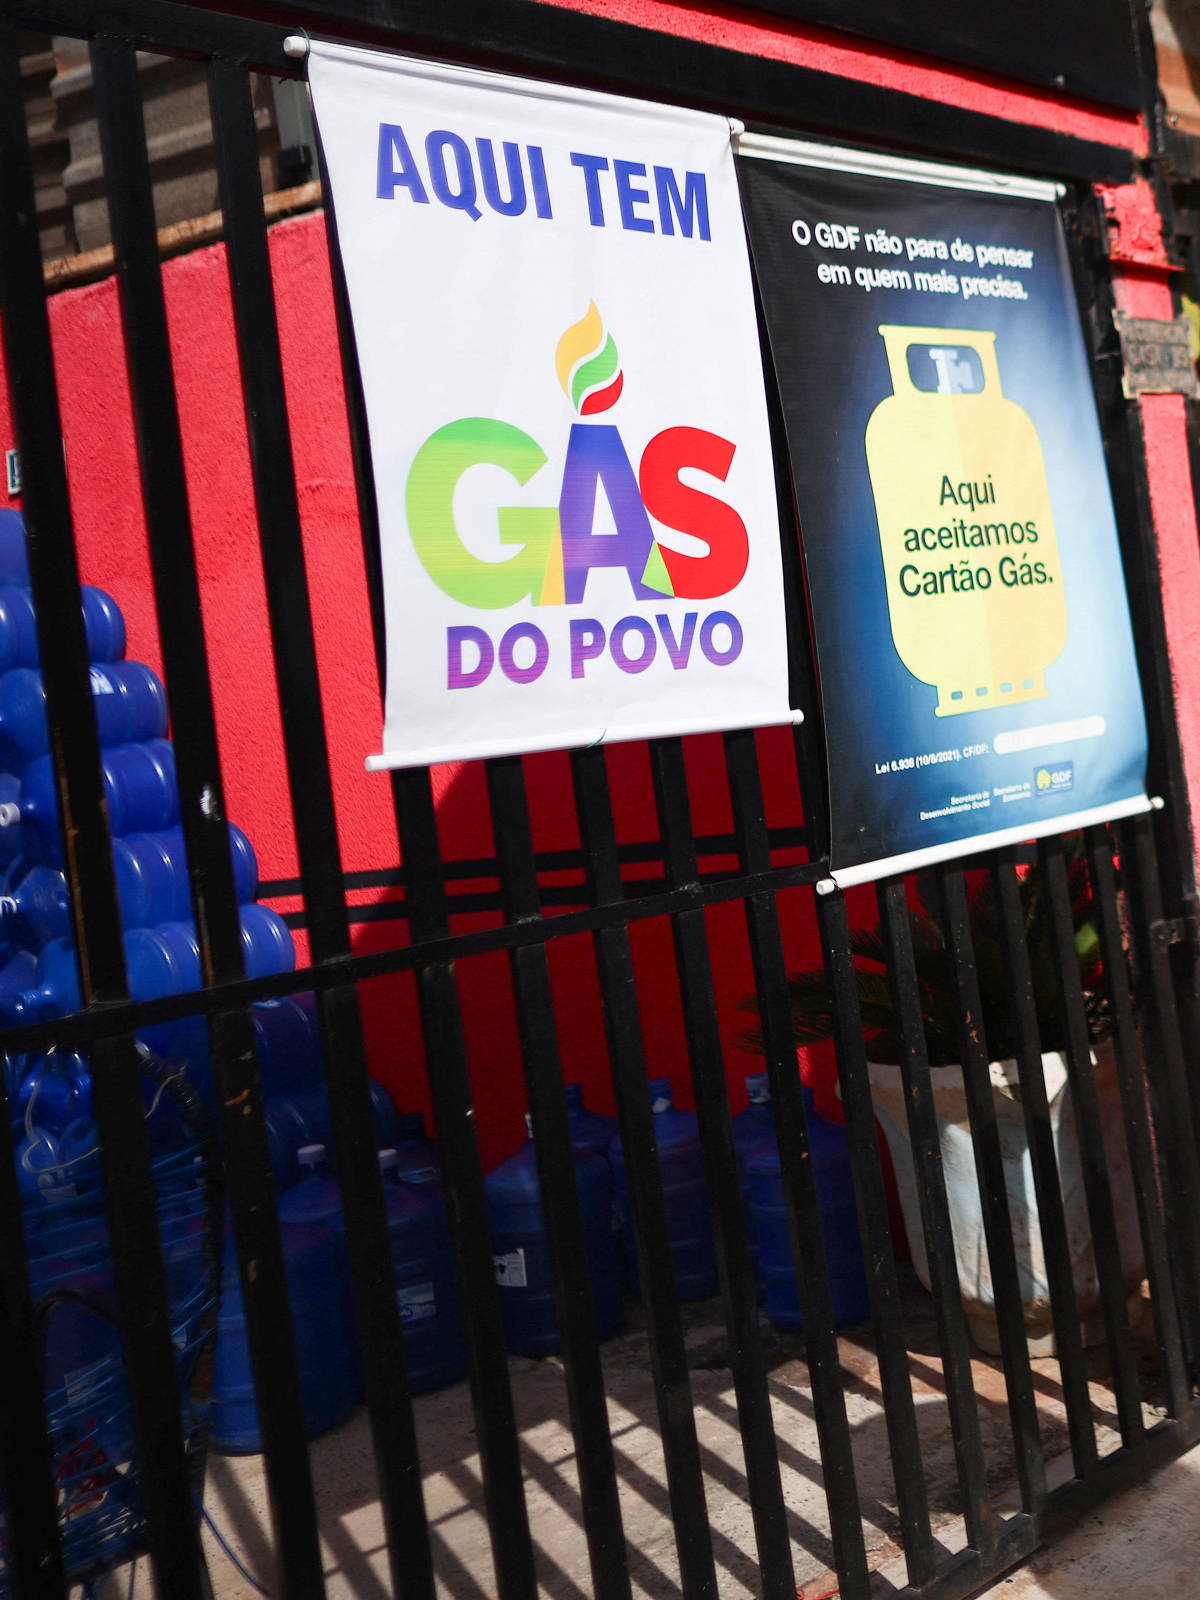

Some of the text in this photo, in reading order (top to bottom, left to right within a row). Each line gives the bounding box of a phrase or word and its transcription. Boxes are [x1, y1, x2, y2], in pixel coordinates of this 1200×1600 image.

[376, 122, 712, 241] AQUI TEM
[791, 219, 1034, 269] O GDF não para de pensar
[816, 263, 1029, 300] em quem mais precisa.
[938, 474, 996, 512] Aqui
[903, 518, 1039, 553] aceitamos
[899, 552, 1054, 597] Cartão Gás.
[446, 610, 744, 691] DO POVO
